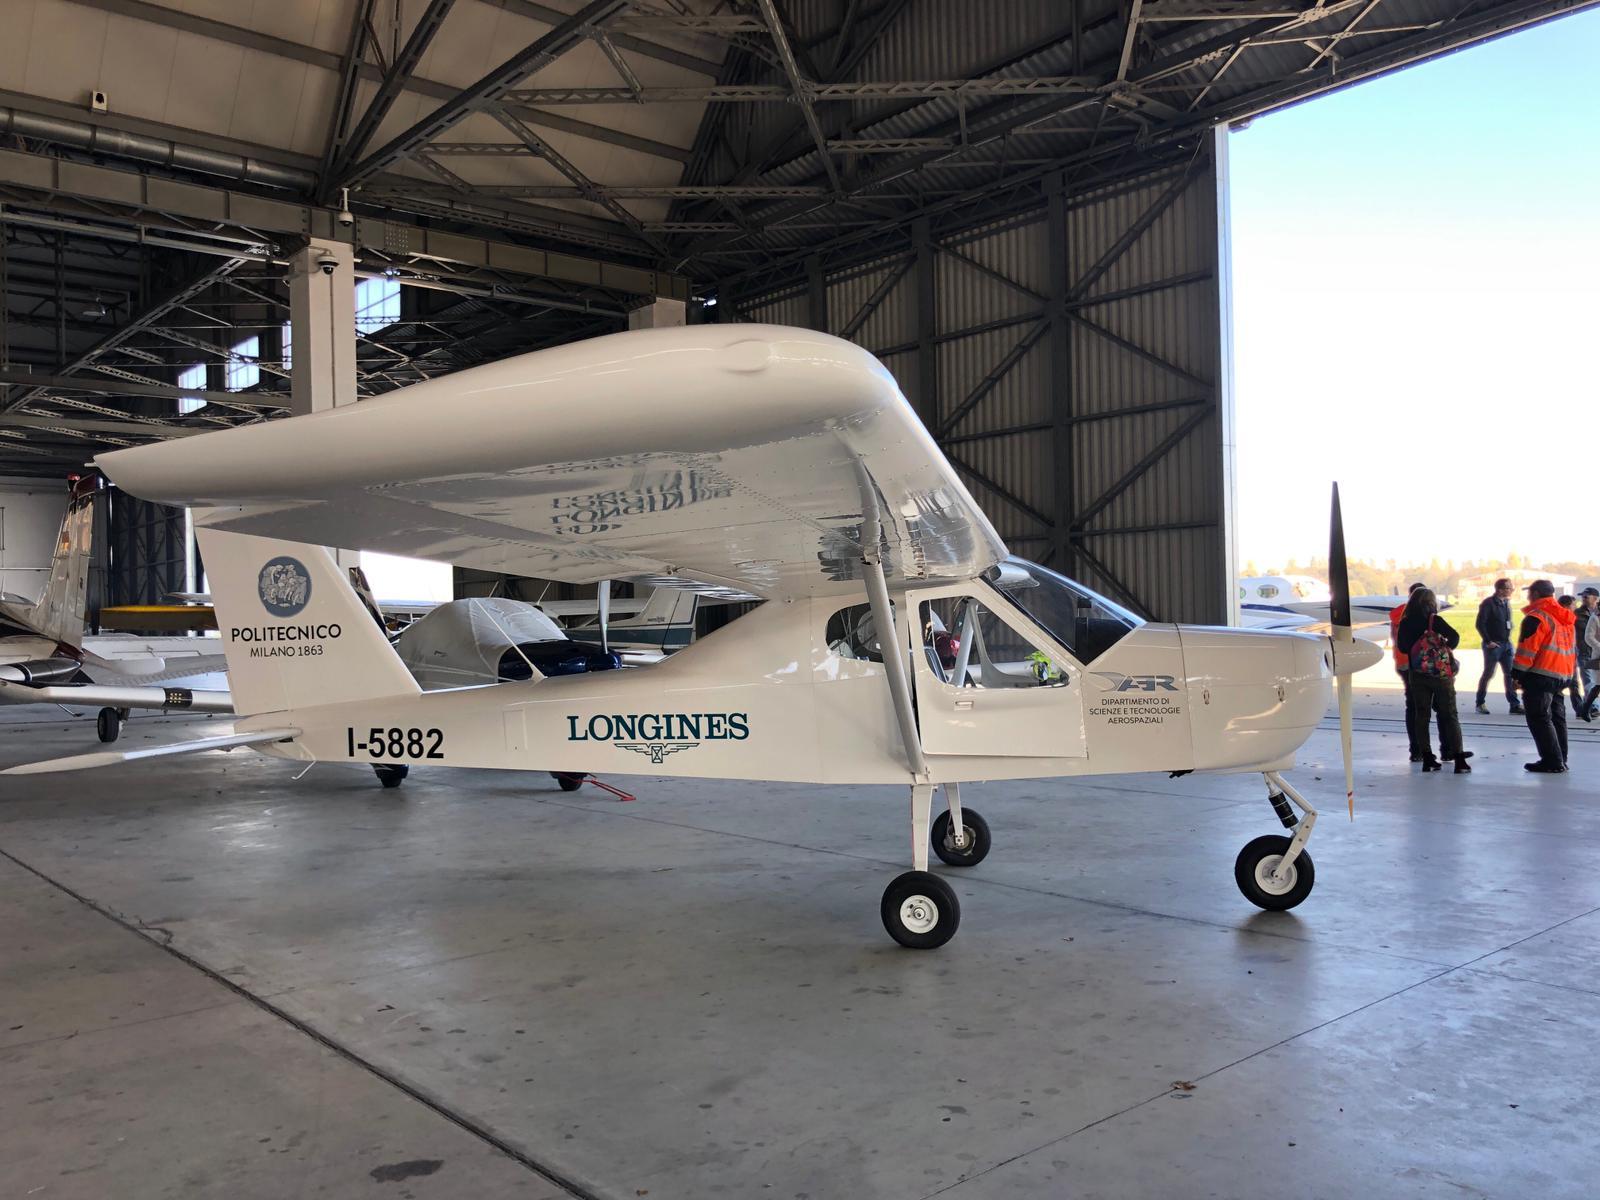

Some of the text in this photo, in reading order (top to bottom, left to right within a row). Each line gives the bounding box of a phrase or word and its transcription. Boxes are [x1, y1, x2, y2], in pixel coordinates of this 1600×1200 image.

[231, 624, 342, 642] POLITECNICO
[250, 645, 324, 658] MILANO 1863
[1101, 698, 1160, 706] DIPARTIMENTO
[1089, 706, 1181, 715] SCIENZE E TECNOLOGIE
[566, 712, 750, 741] LONGINES
[1107, 716, 1164, 725] AEROSPAZIALI
[347, 727, 445, 759] I-5882
